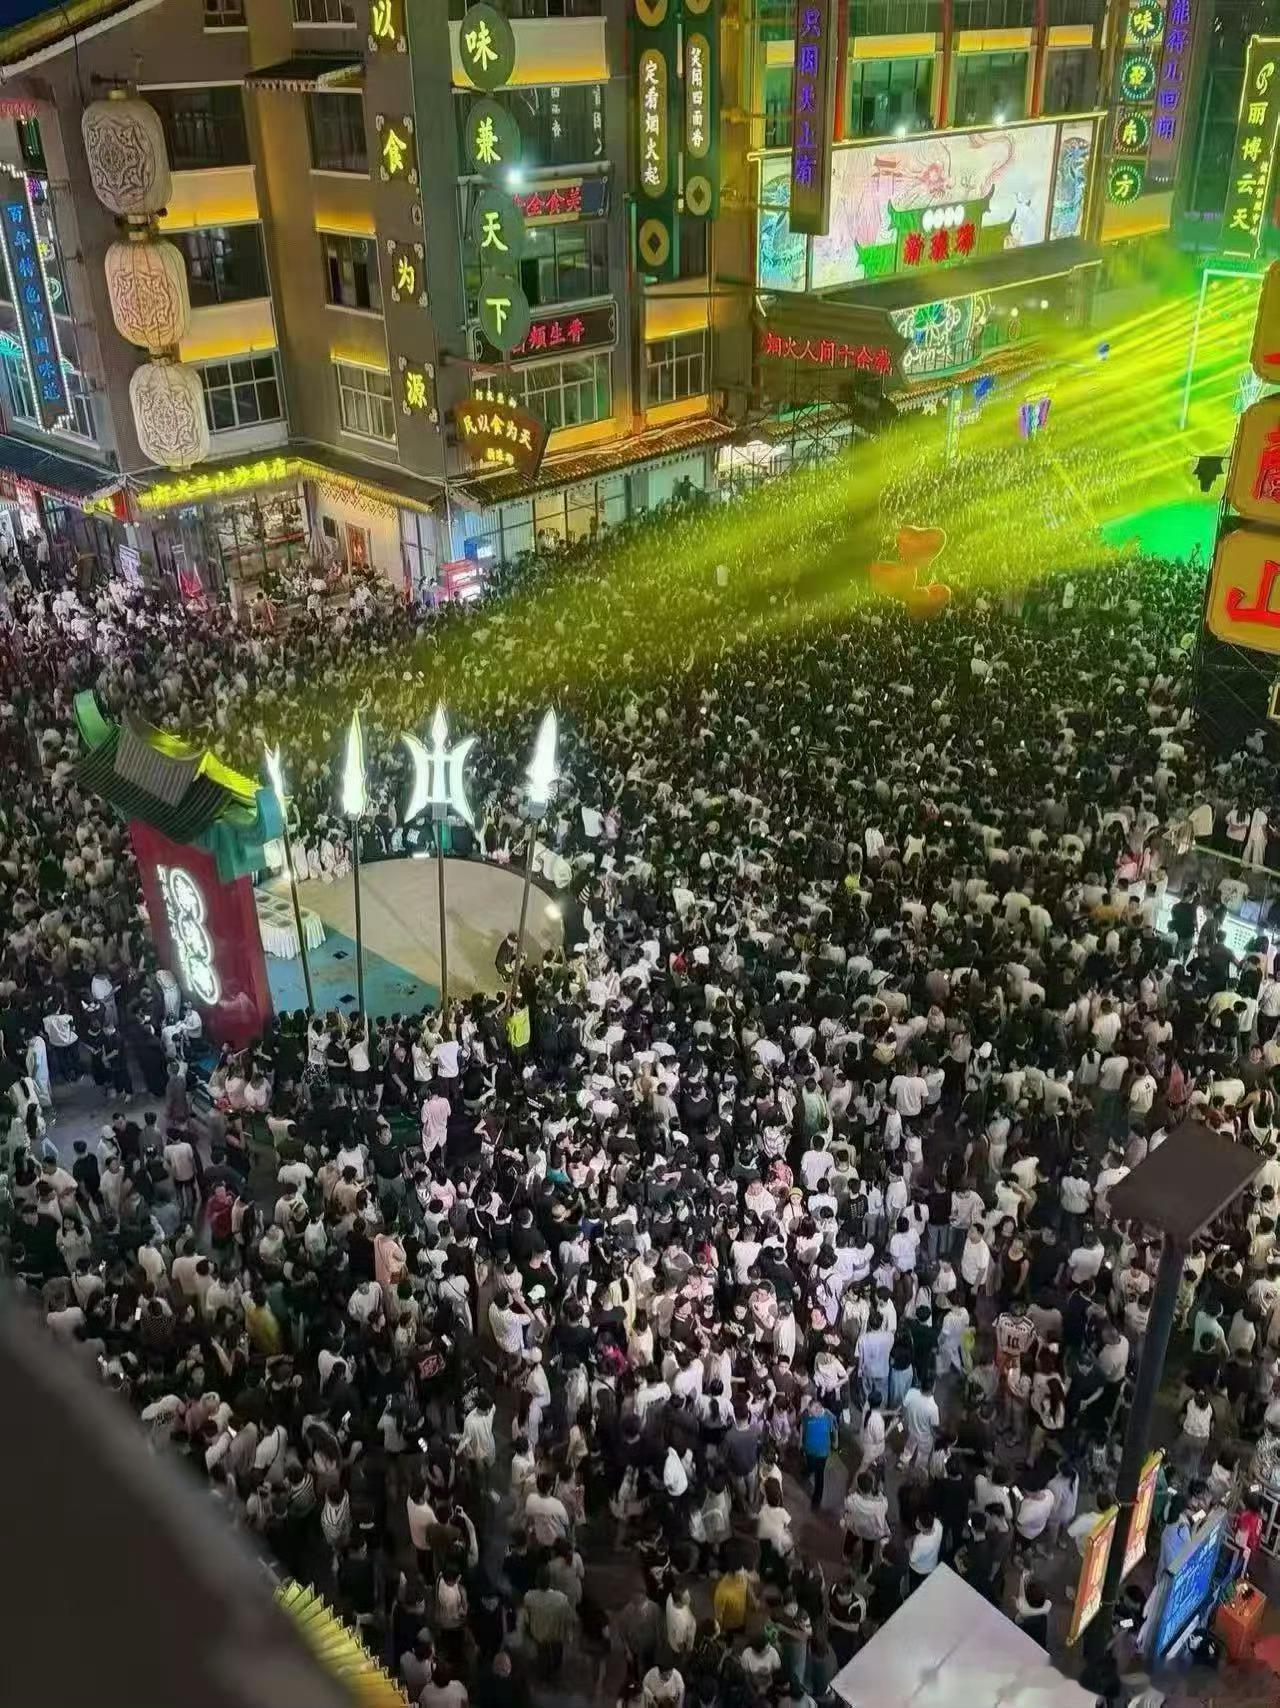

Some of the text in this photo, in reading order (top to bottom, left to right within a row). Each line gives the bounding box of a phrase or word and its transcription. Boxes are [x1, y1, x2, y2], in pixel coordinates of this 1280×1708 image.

[463, 413, 533, 451] 民以食为天
